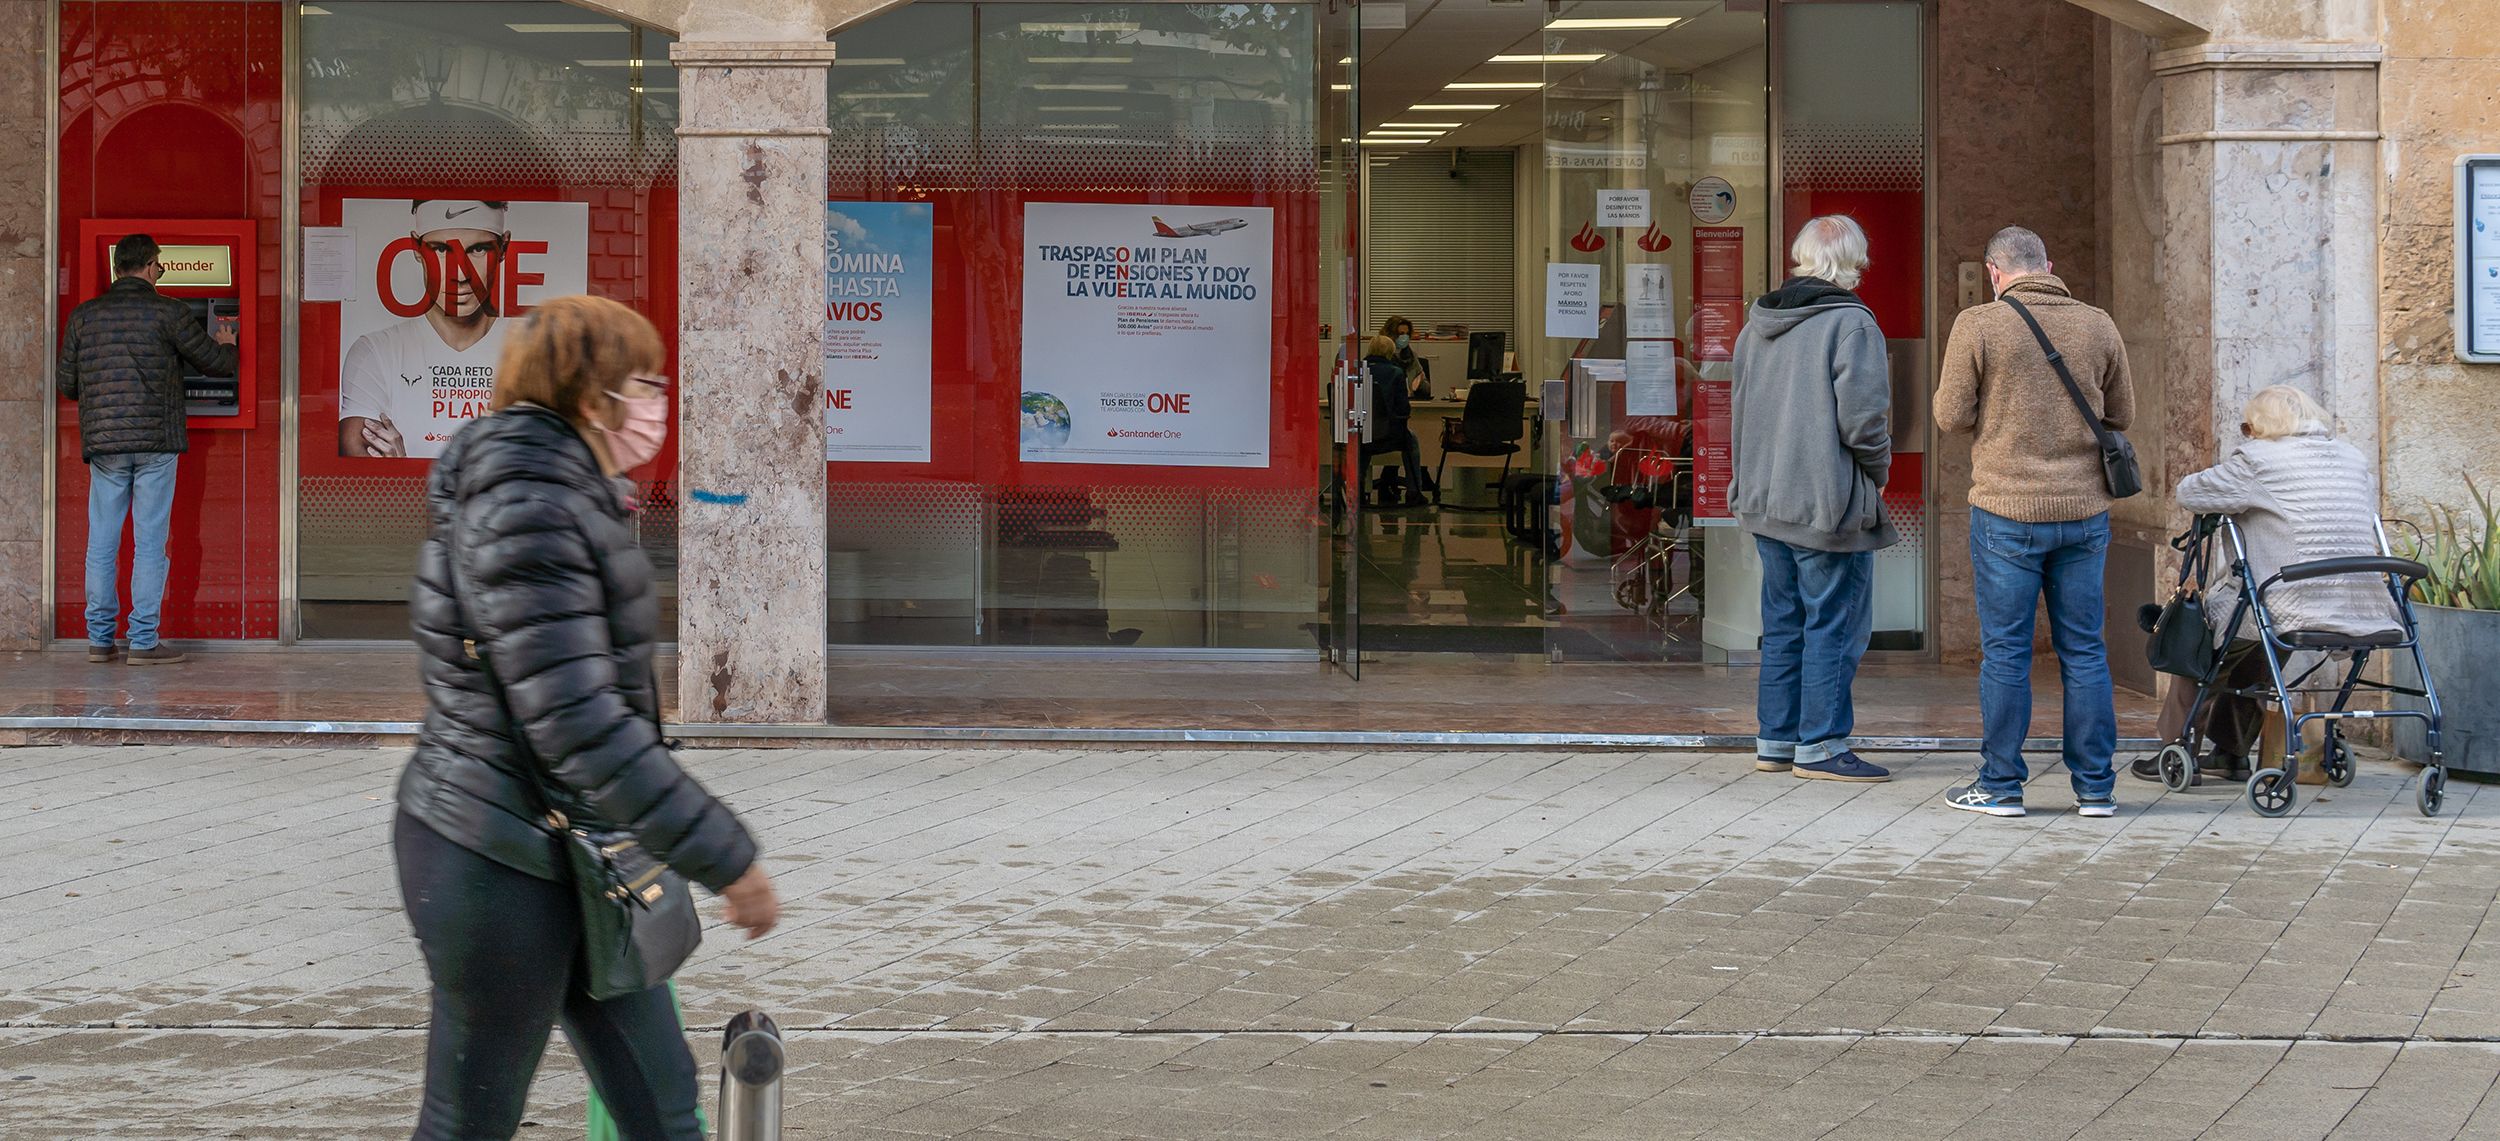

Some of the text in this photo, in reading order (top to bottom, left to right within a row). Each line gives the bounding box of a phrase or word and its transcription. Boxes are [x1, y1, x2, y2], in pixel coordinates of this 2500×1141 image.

[1695, 229, 1740, 238] Bienvenido
[1039, 245, 1207, 264] TRASPASO MI PLAN
[162, 260, 215, 271] ntander
[376, 236, 549, 318] ONE
[1067, 263, 1251, 283] DE PENSIONES Y DOY
[828, 277, 900, 297] HASTA
[1067, 281, 1257, 301] LA VUELTA AL MUNDO
[465, 366, 494, 377] RETO
[432, 377, 493, 388] REQUIERE
[432, 389, 493, 400] SU PROPIO
[1100, 398, 1116, 406] TUS
[1147, 392, 1190, 414] ONE
[1119, 429, 1182, 439] Santander One
